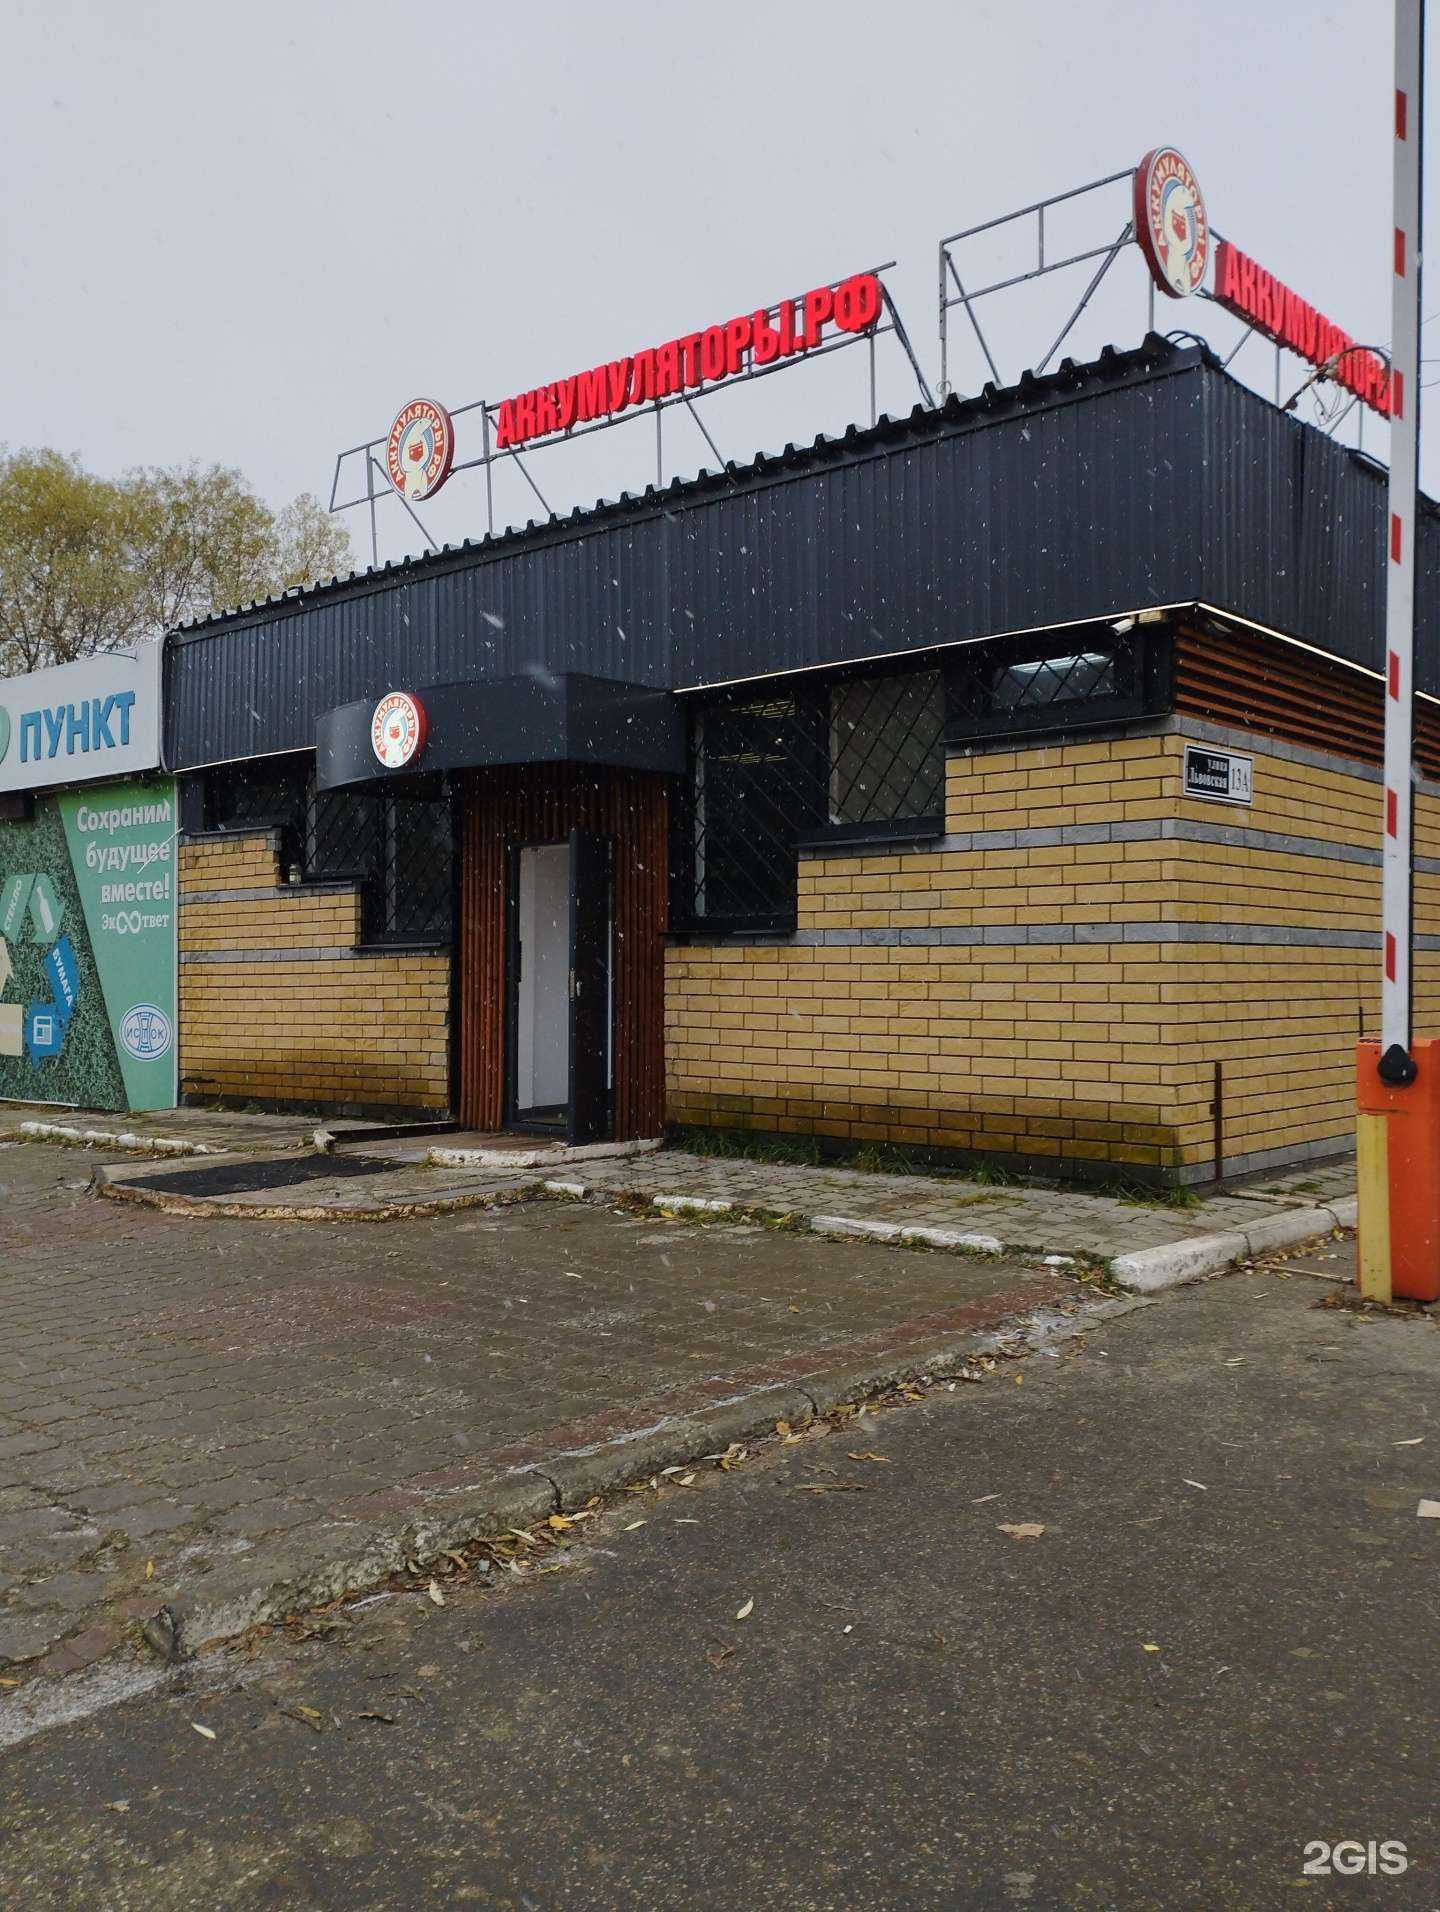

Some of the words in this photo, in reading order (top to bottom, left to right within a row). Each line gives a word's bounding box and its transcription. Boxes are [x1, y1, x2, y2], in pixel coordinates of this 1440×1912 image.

[496, 273, 884, 449] АККУМУЛЯТОРЫ.РФ
[389, 404, 444, 482] АККУМУЛЯТОРЫ
[427, 454, 442, 478] РФ
[20, 690, 136, 763] ПУНКТ
[77, 798, 171, 835] Сохраним
[86, 840, 170, 874] будущее
[4, 879, 22, 931] СТЕКЛО
[101, 872, 170, 903] вместе!
[52, 948, 74, 1007] БУМАГА
